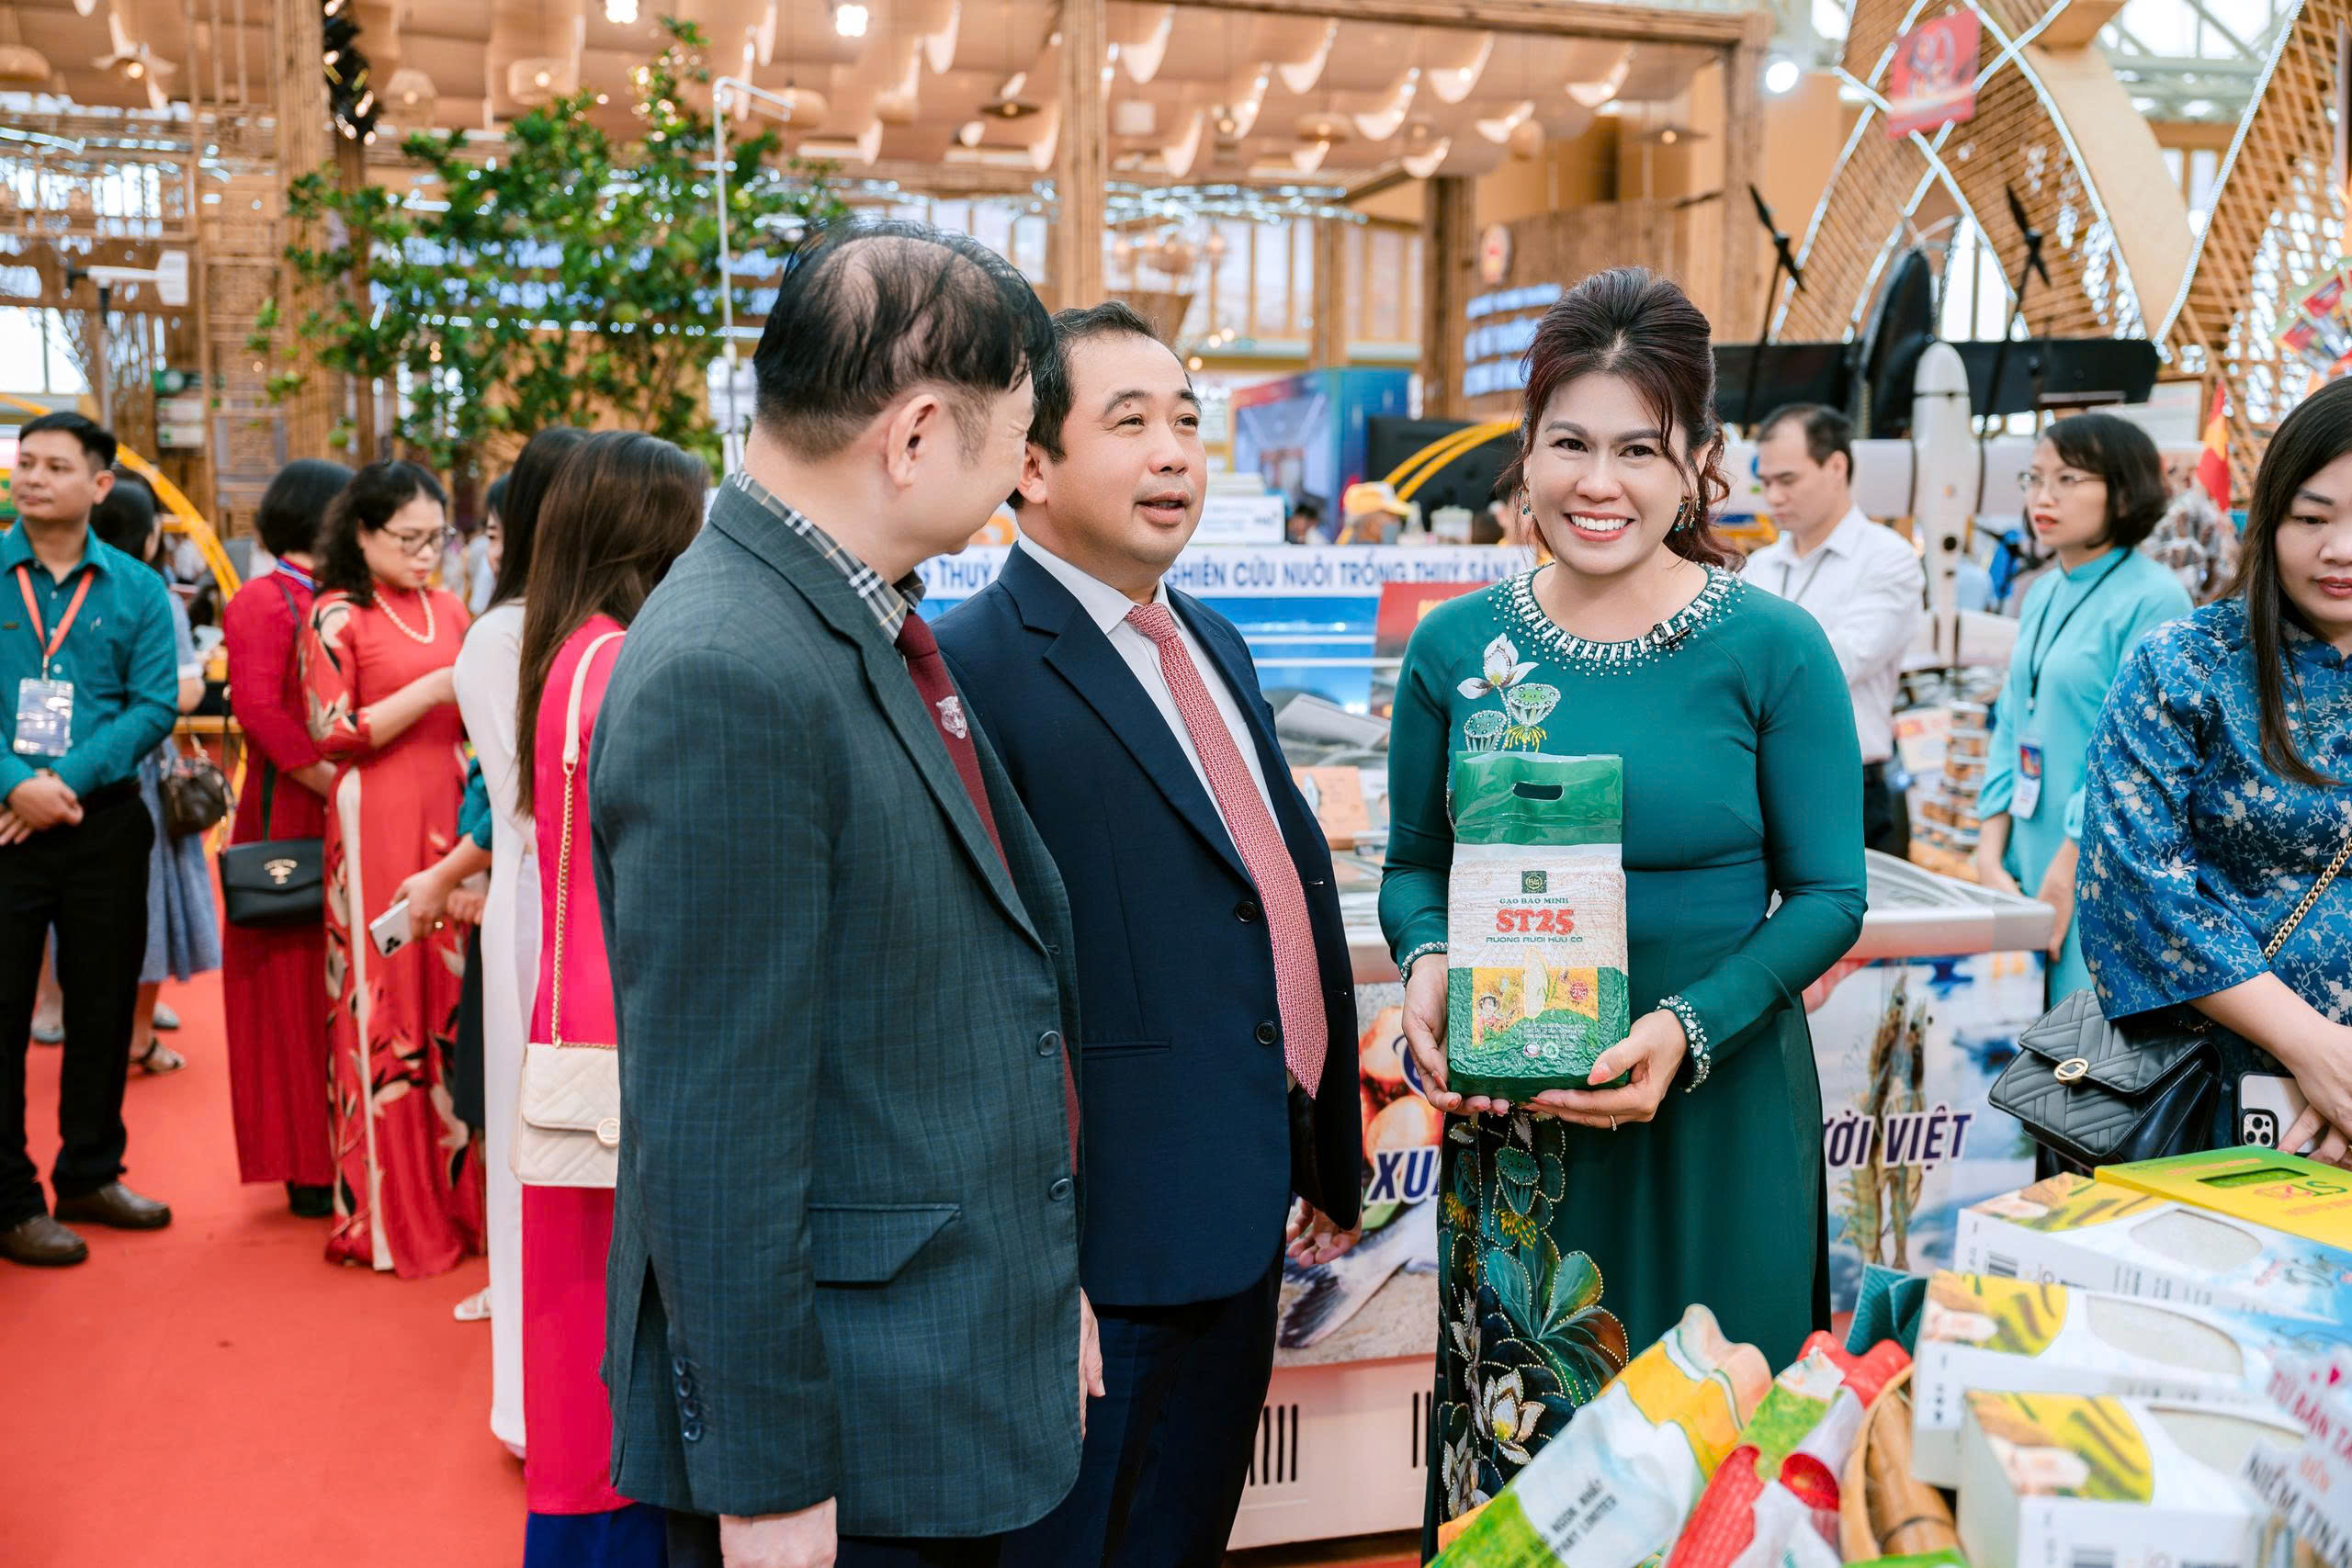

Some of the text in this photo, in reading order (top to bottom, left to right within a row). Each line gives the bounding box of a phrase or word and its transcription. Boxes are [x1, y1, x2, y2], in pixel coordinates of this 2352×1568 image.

[1162, 554, 1226, 586] GHIÊN
[1496, 908, 1574, 935] ST25
[1823, 1105, 1973, 1170] ỜI VIỆT
